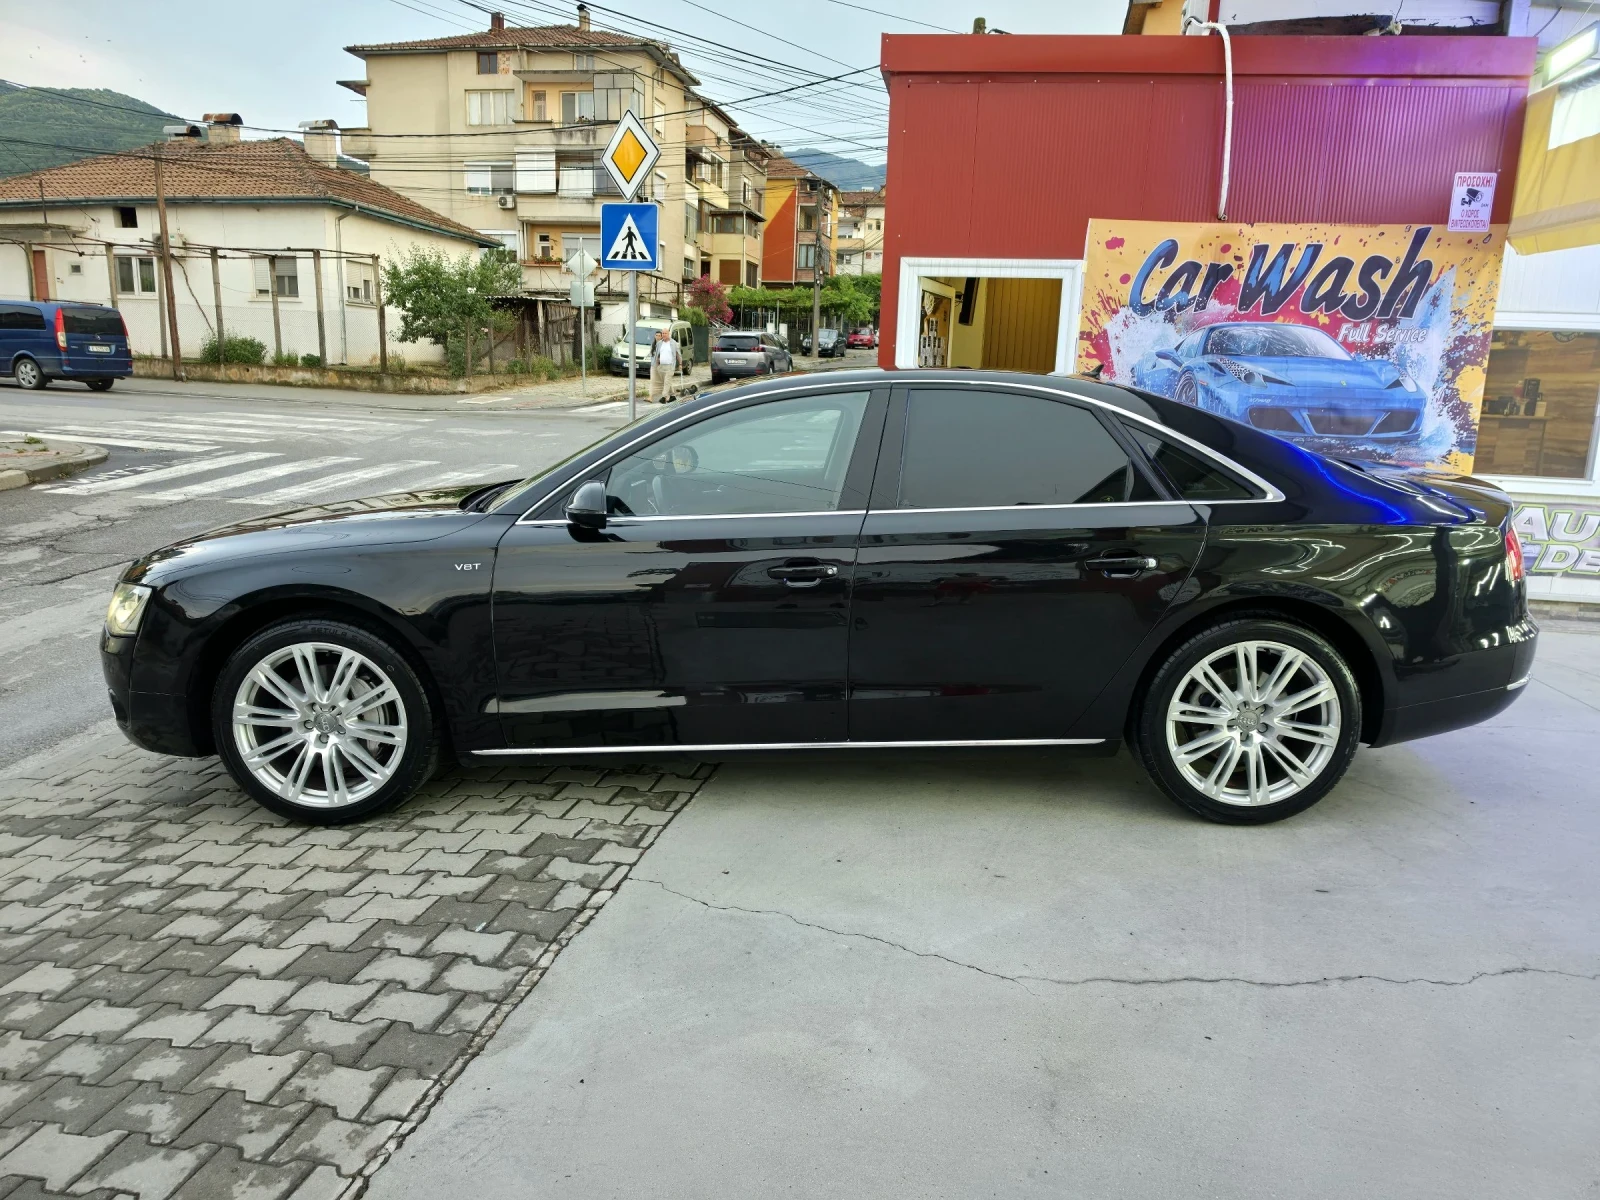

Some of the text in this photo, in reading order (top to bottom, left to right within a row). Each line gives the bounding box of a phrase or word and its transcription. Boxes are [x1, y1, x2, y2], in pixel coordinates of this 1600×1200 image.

[1456, 175, 1494, 188] ΠΡΟΣΟΧΗ!
[1129, 225, 1434, 321] Car Wash
[1339, 322, 1427, 343] Full Service
[454, 562, 482, 571] V8T
